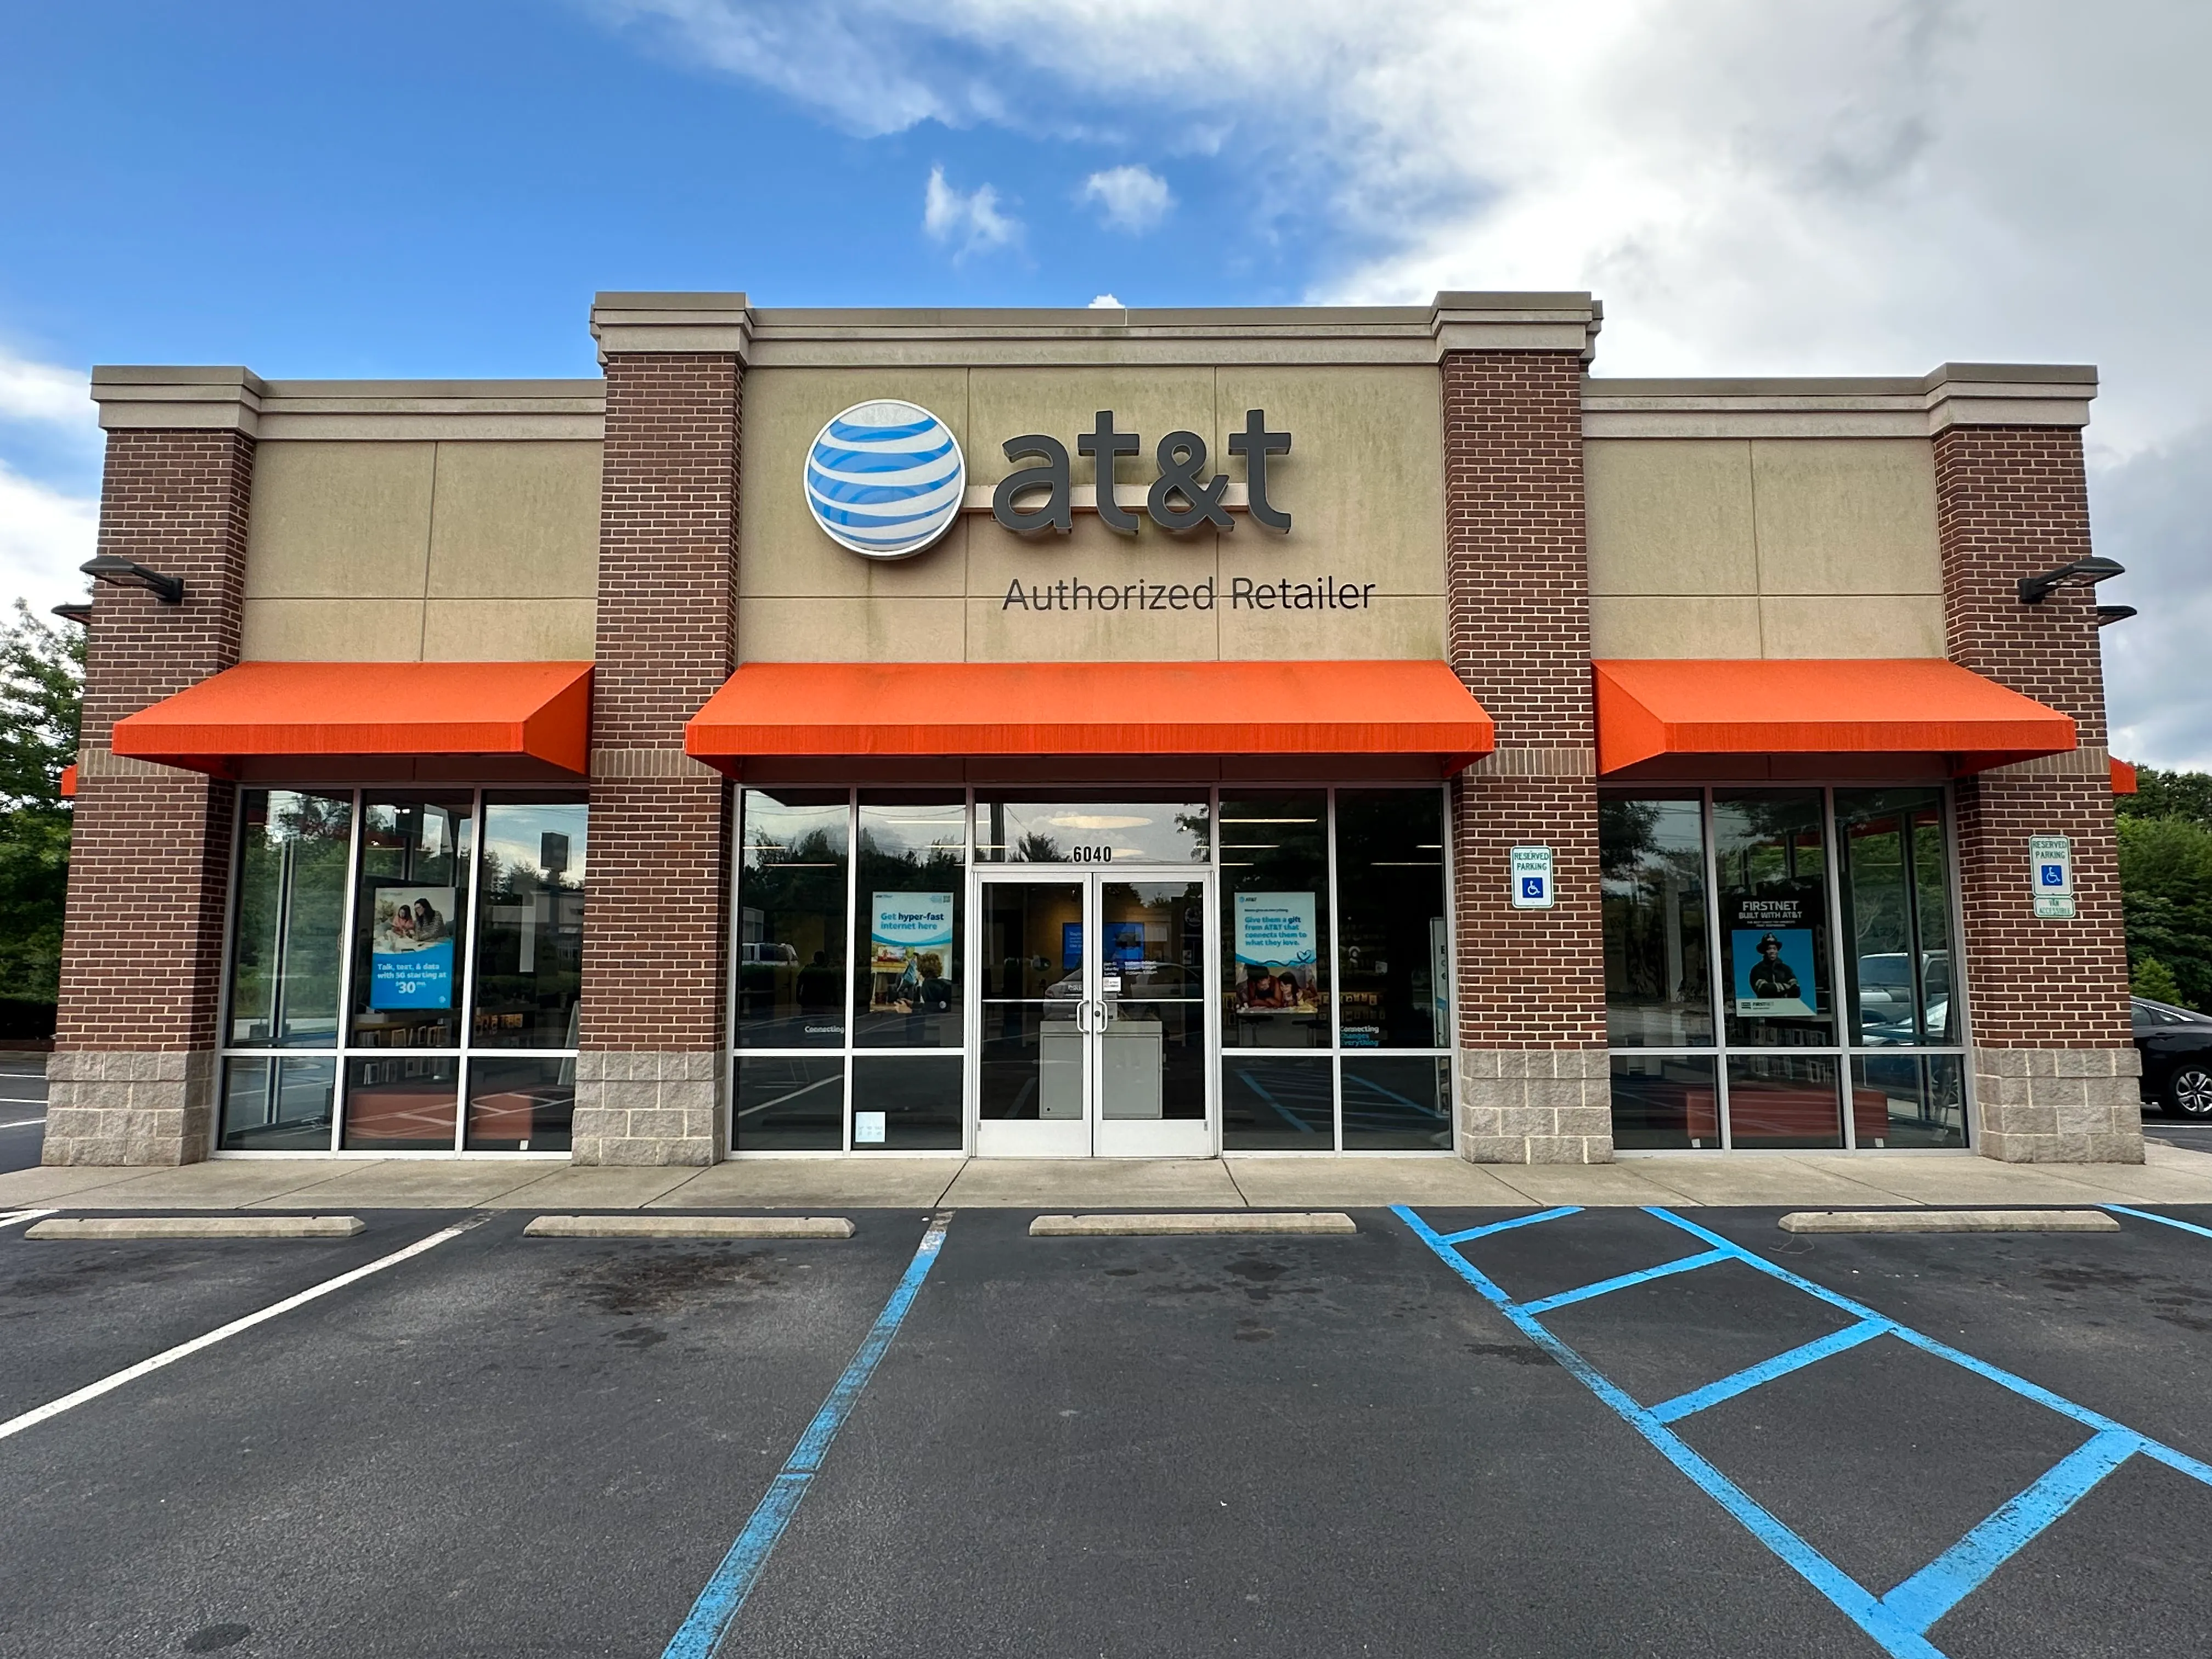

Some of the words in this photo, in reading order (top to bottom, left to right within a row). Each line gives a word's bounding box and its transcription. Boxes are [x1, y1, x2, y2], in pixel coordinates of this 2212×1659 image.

[992, 409, 1292, 534] at&t
[1002, 577, 1214, 611] Authorized
[1232, 575, 1376, 610] Retailer
[2032, 840, 2067, 849] RESERVED
[1073, 846, 1111, 862] 6040
[1514, 852, 1549, 860] RESERVED
[1516, 862, 1548, 871] PARKING
[1742, 901, 1800, 911] FIRSTNET
[898, 912, 944, 922] hyper-fast
[1288, 916, 1301, 924] gift
[1265, 939, 1281, 947] they
[407, 972, 437, 980] starting
[804, 1025, 845, 1034] Connecting
[1340, 1025, 1379, 1034] Connecting
